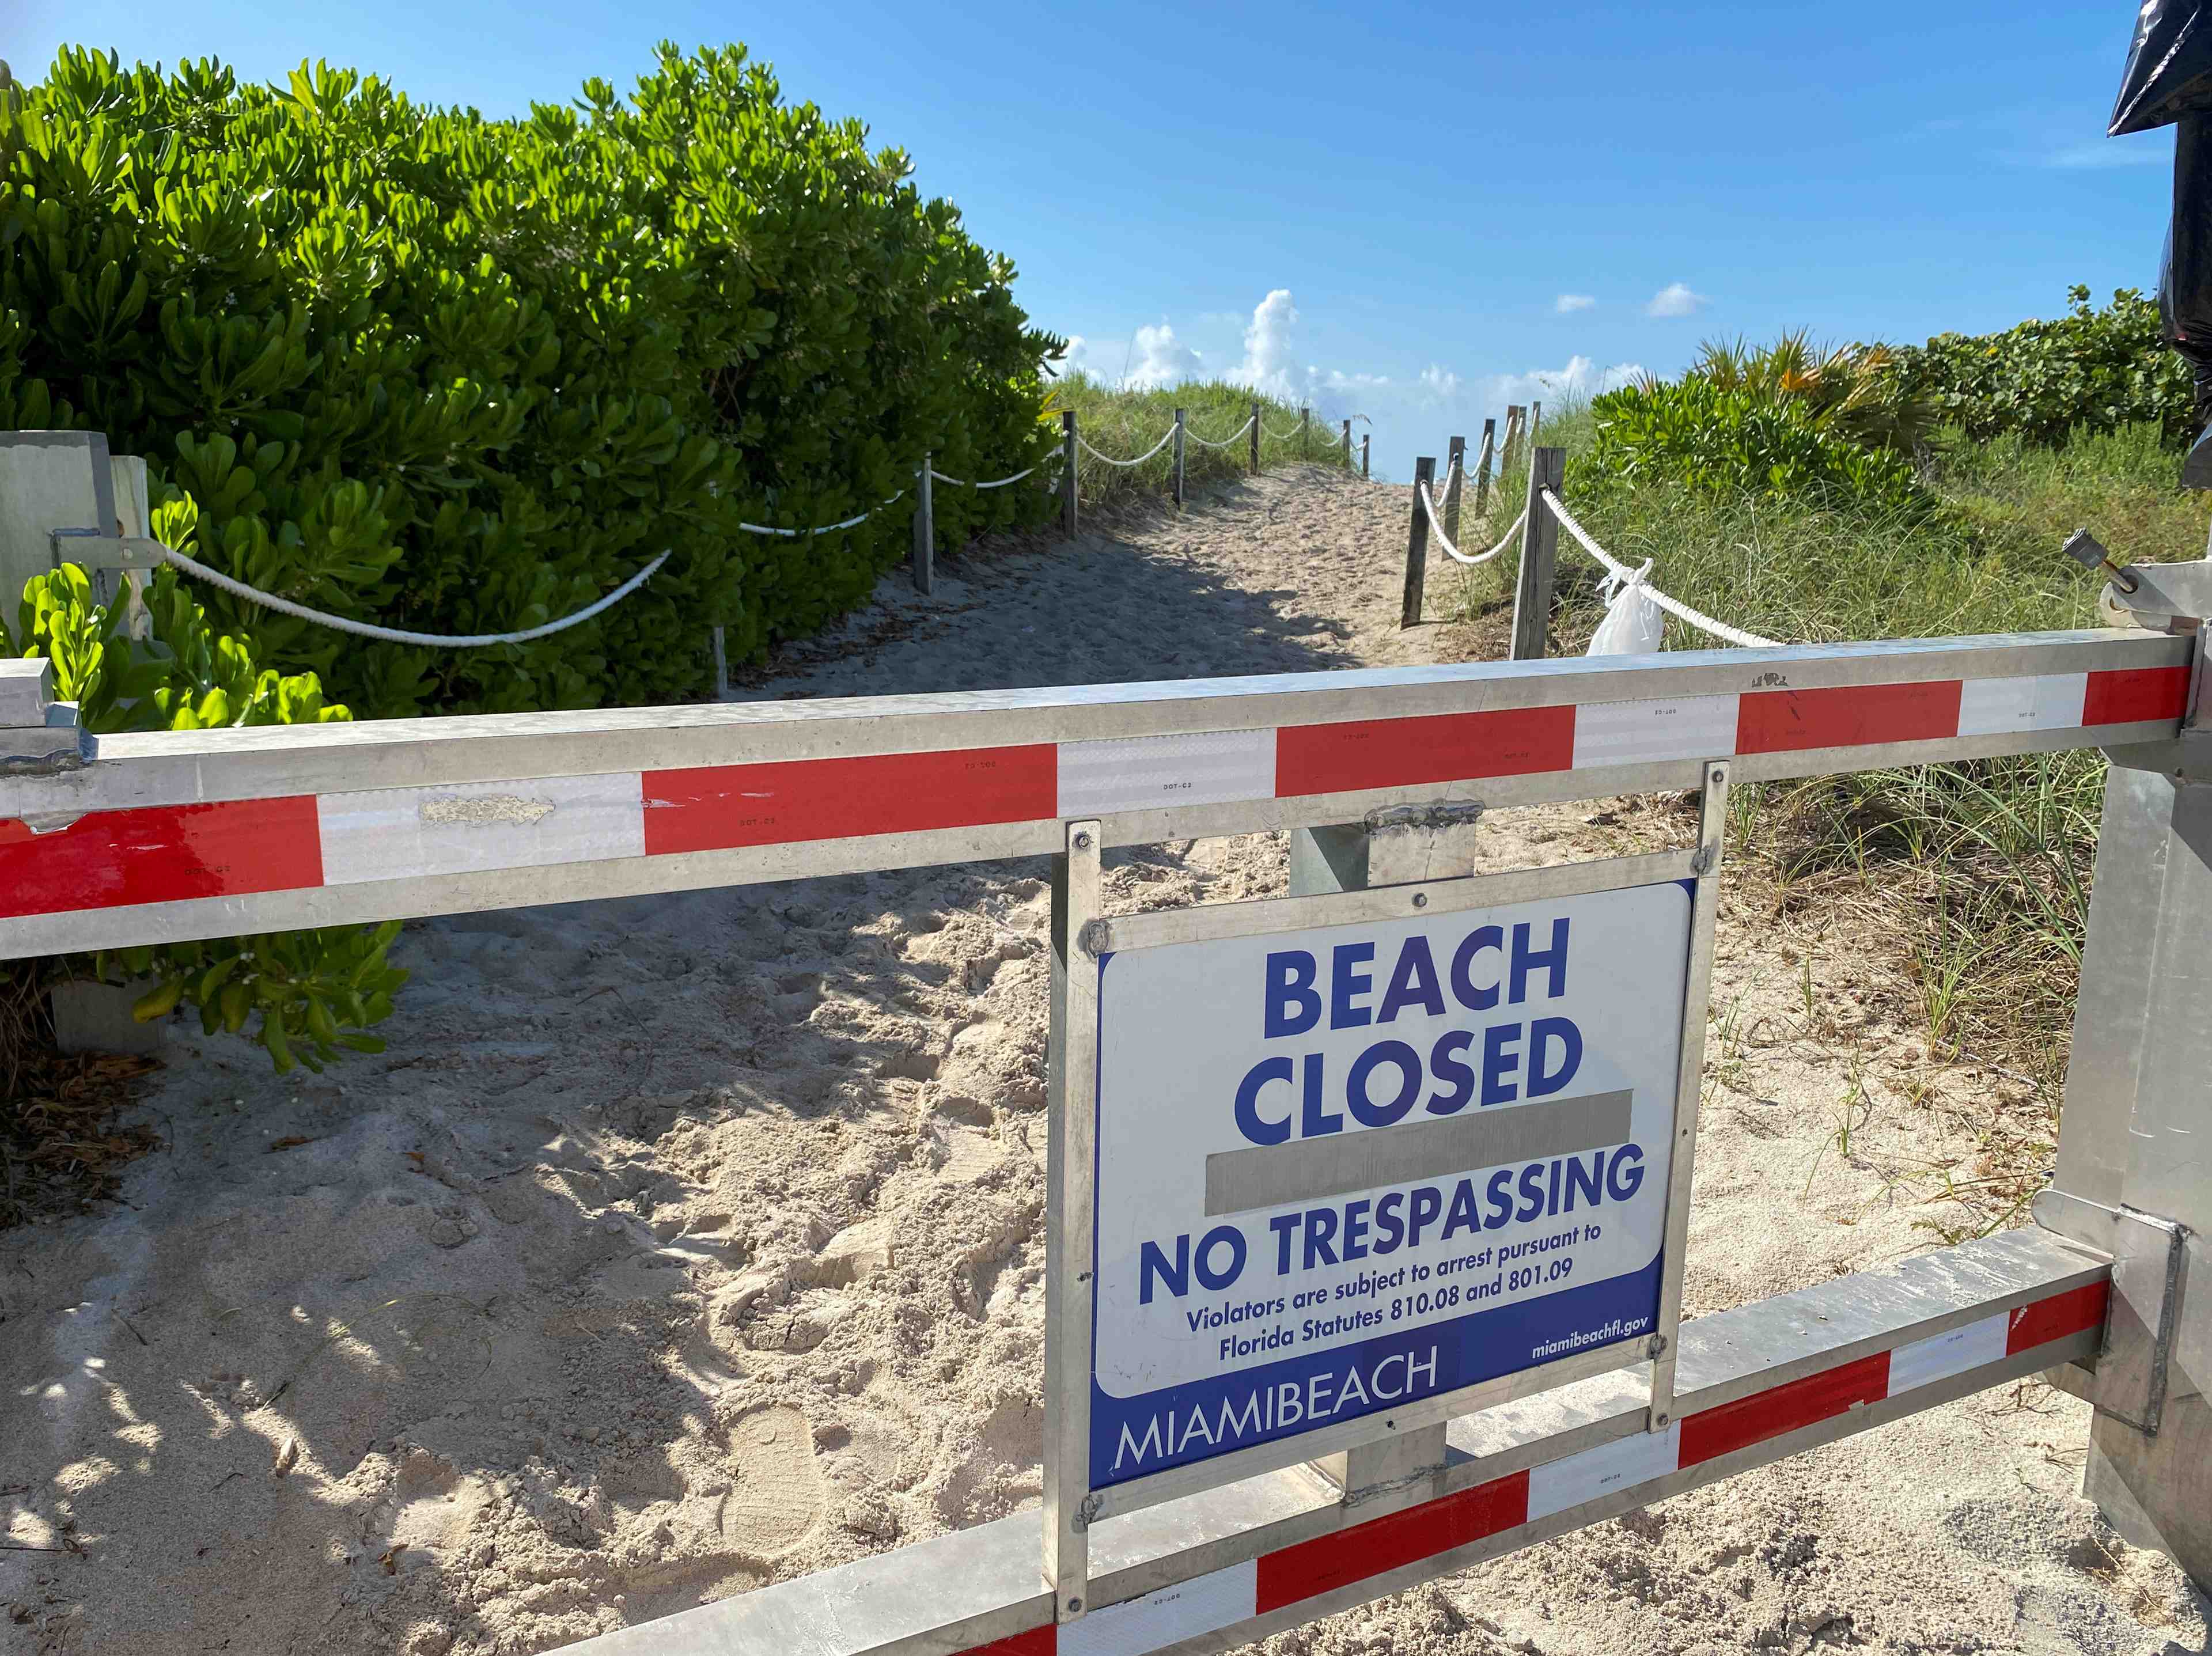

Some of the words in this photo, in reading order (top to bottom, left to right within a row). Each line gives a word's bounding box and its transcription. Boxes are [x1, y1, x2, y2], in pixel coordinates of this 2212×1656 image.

[1264, 918, 1570, 1039] BEACH
[1234, 1017, 1583, 1146] CLOSED
[1139, 1225, 1247, 1305] NO
[1270, 1143, 1645, 1275] TRESPASSING
[1187, 1297, 1285, 1332] Violators
[1293, 1289, 1328, 1309] are
[1335, 1268, 1406, 1300] subject
[1412, 1264, 1430, 1283] to
[1437, 1248, 1493, 1276] arrest
[1498, 1227, 1580, 1268] pursuant
[1585, 1224, 1601, 1242] to
[1220, 1325, 1294, 1361] Florida
[1302, 1308, 1383, 1342] Statutes
[1391, 1284, 1460, 1320] 810.08
[1466, 1273, 1502, 1302] and
[1509, 1257, 1573, 1291] 801.09
[1532, 1317, 1649, 1359] miamibeachfl.gov
[1114, 1345, 1438, 1469] MIAMIBEACH
